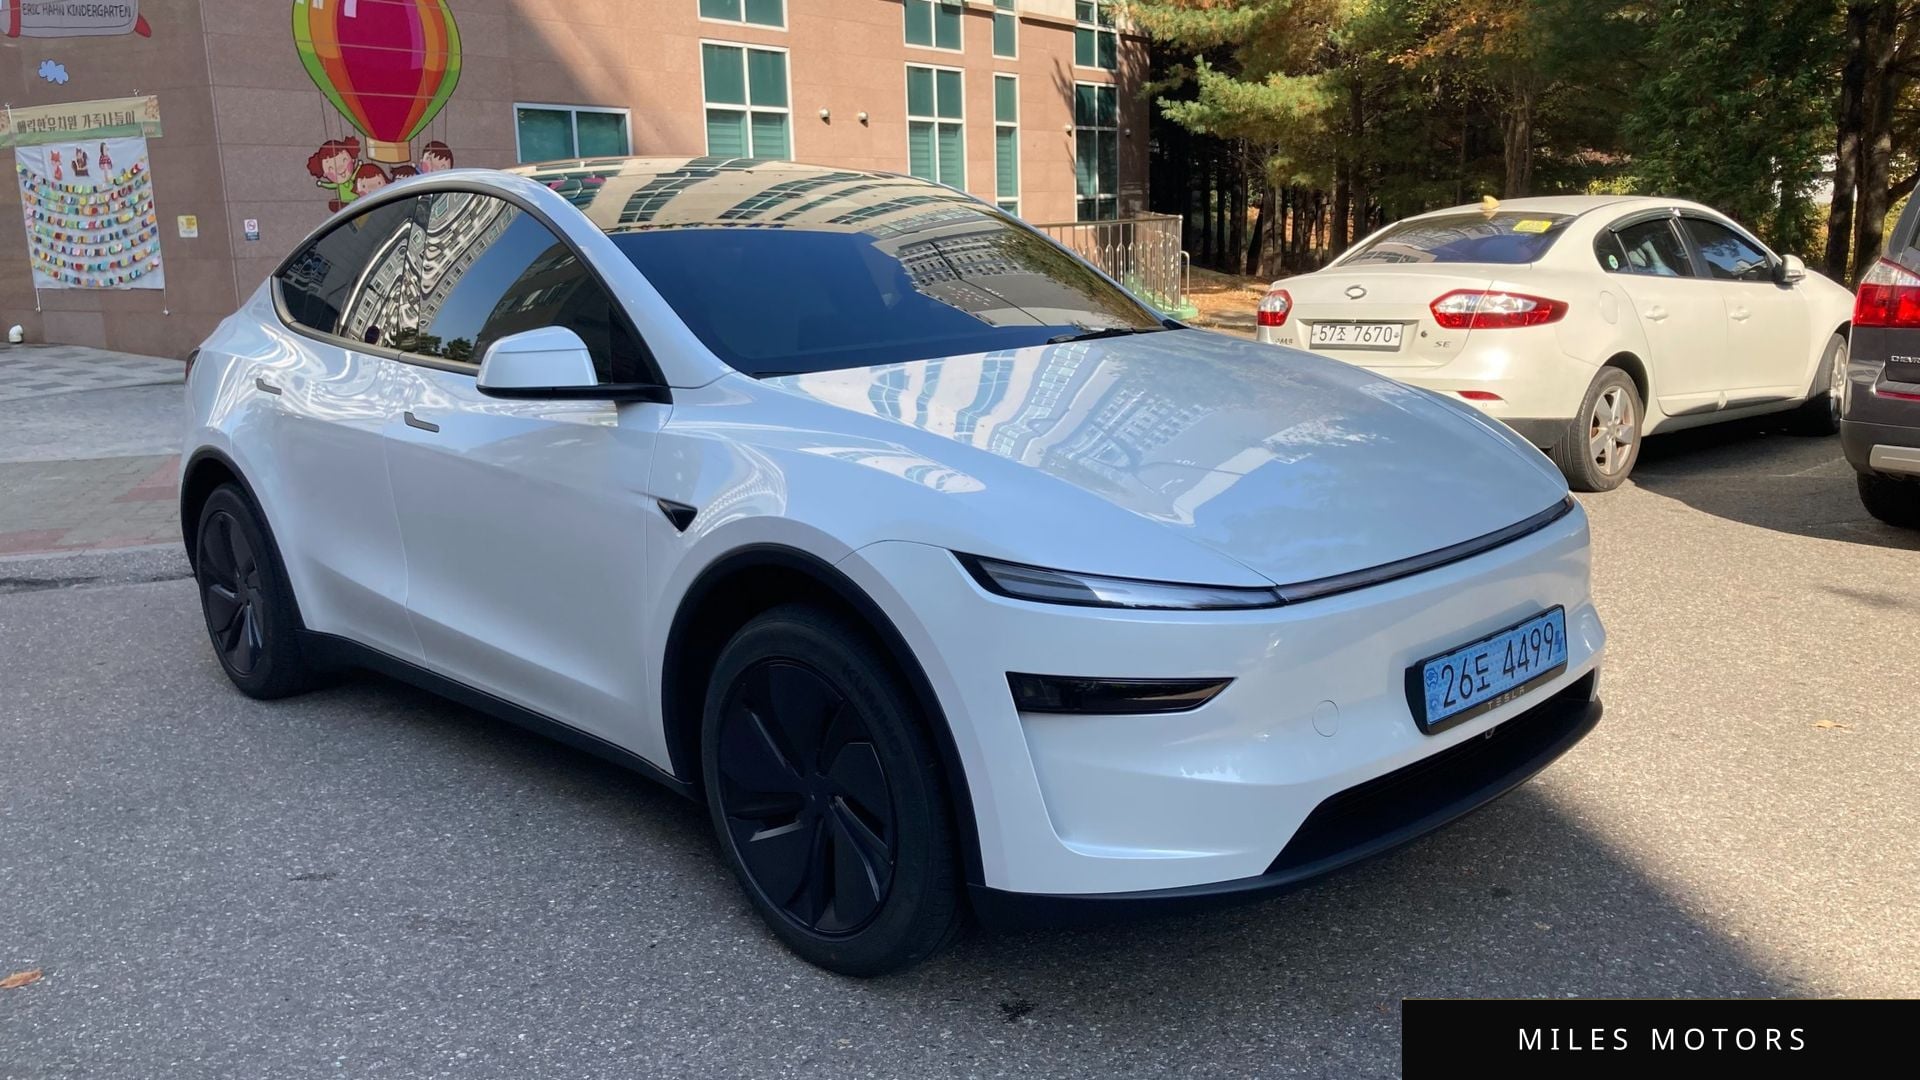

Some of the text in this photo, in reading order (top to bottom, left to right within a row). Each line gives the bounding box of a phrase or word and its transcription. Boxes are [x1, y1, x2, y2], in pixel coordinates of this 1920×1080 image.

[22, 3, 132, 18] ERIC HAHN KINDERGARTEN
[81, 110, 136, 129] 가족나들이
[1318, 325, 1393, 343] 57조 7670
[1433, 340, 1452, 348] SE
[1440, 621, 1555, 709] 26도 4499
[1487, 686, 1525, 710] TESLA
